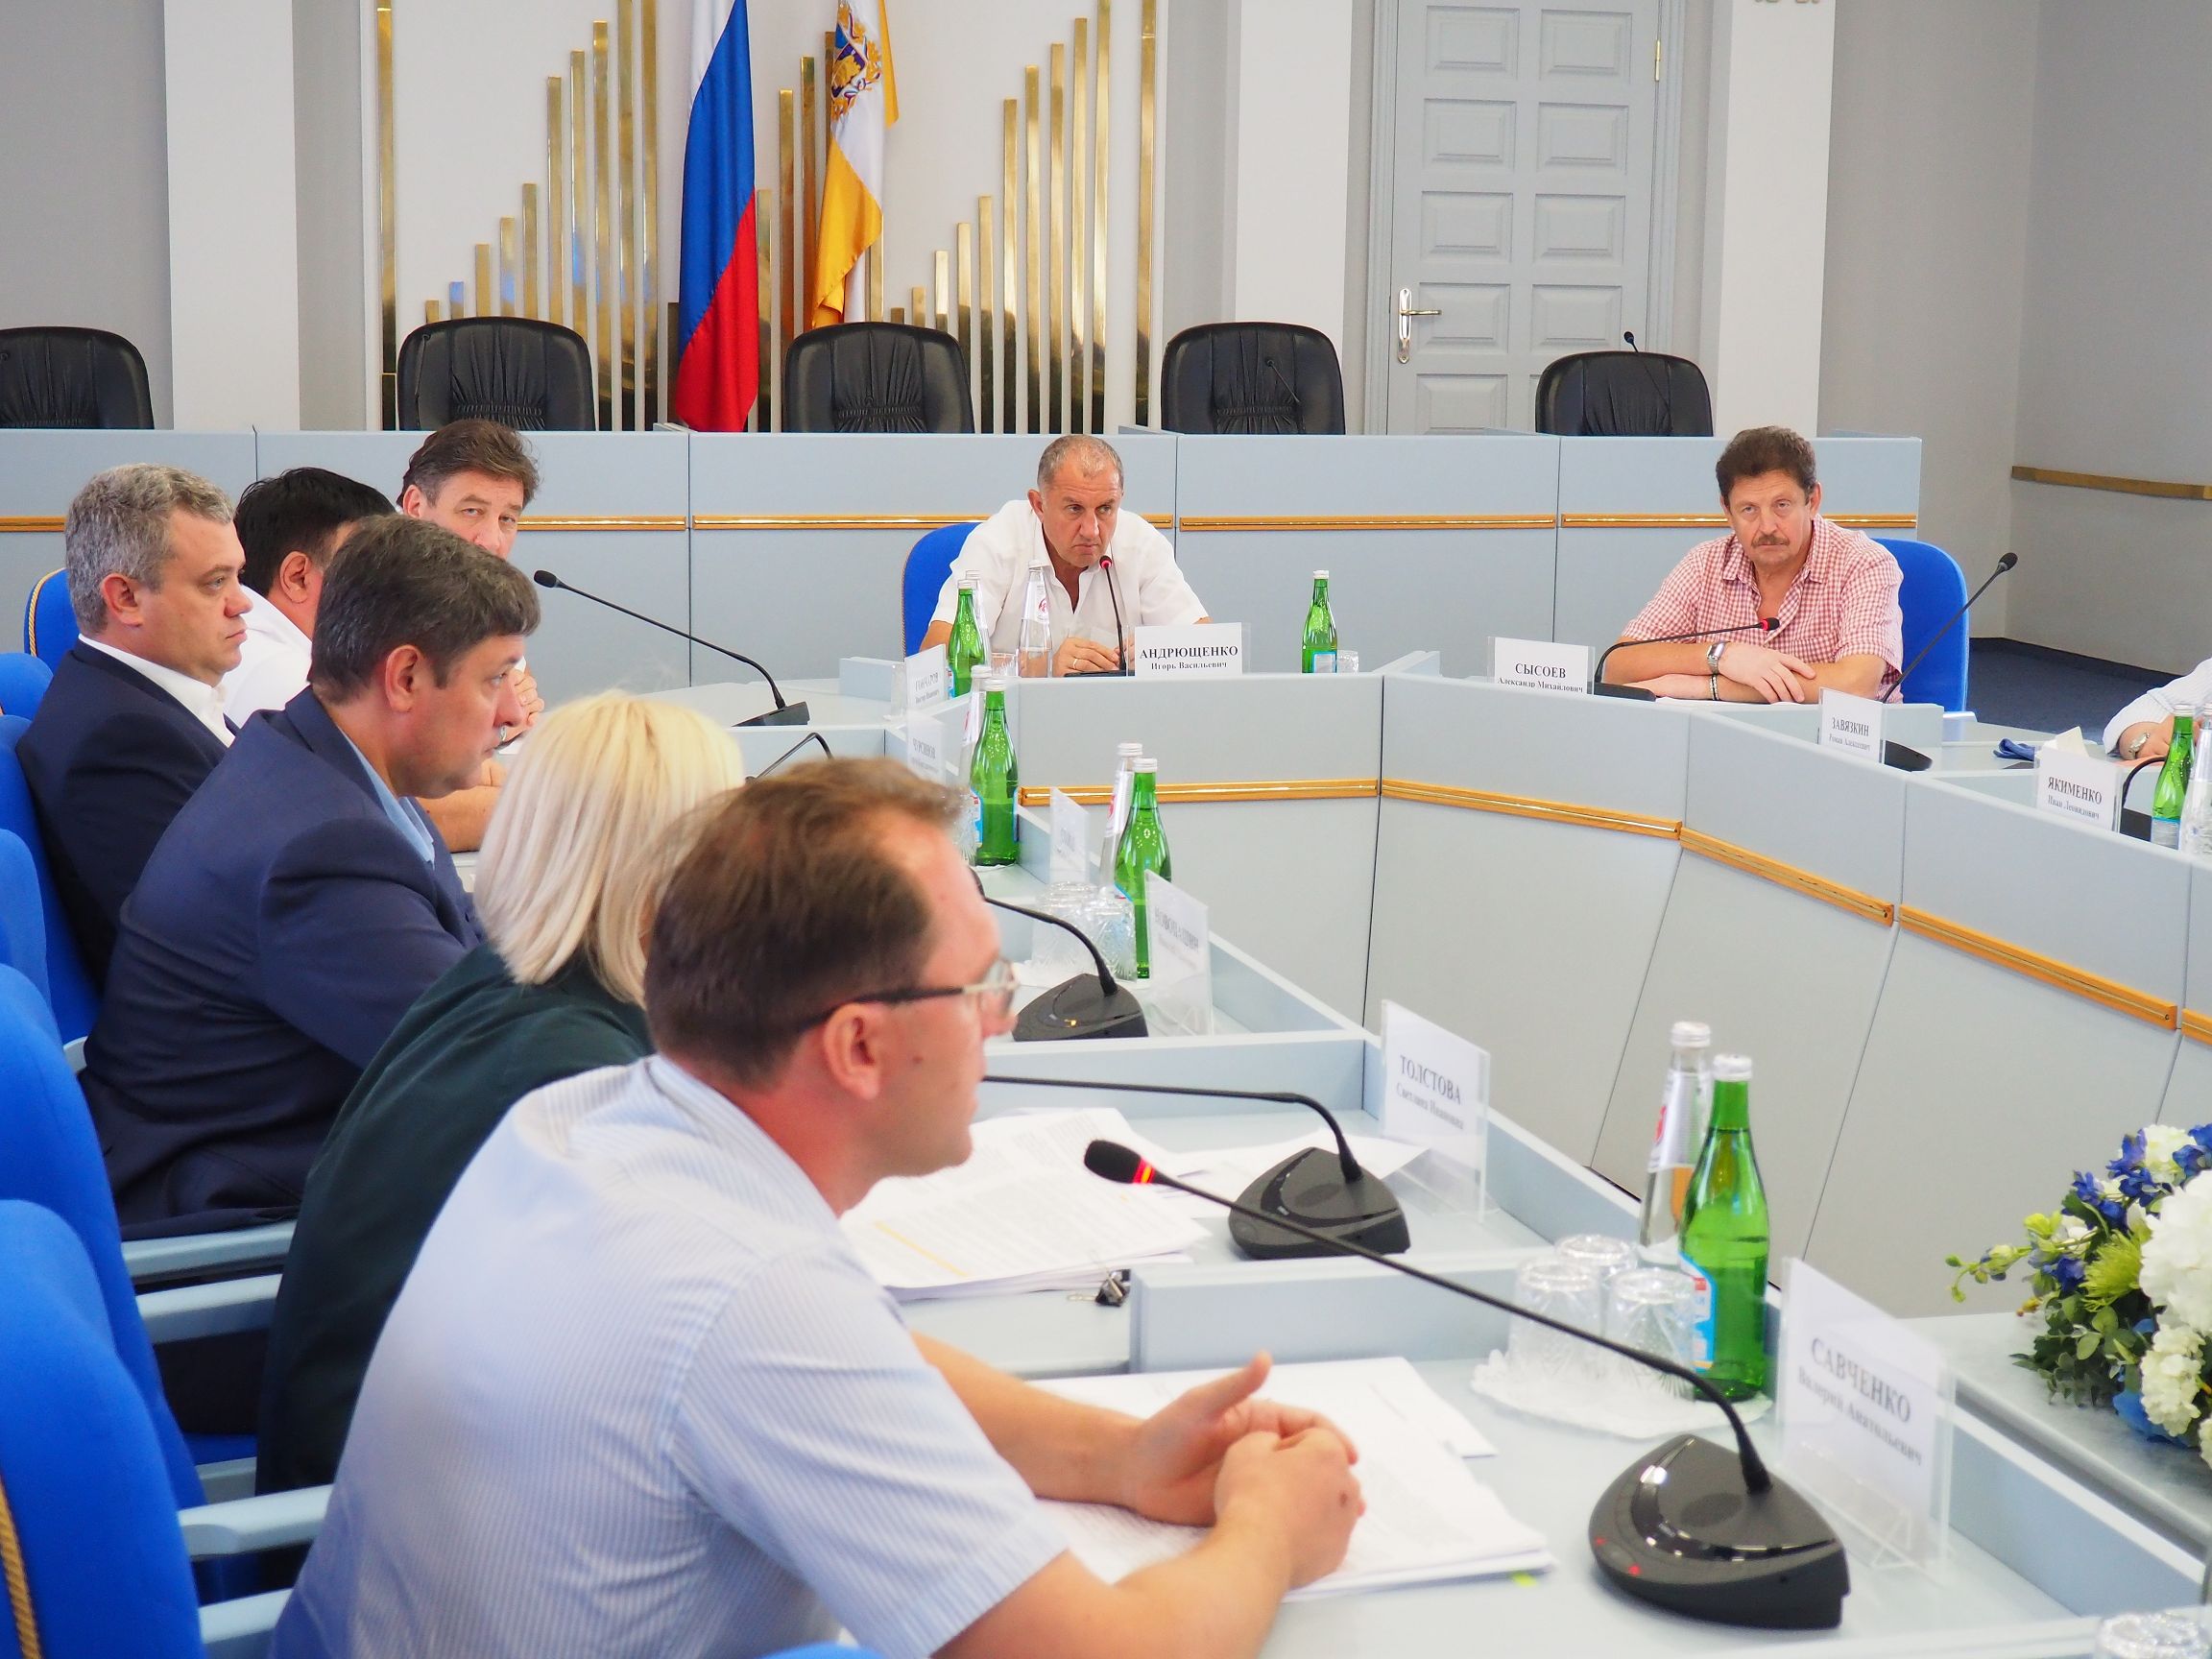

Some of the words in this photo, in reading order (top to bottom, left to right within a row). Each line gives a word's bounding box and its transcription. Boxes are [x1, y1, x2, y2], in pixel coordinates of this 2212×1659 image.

[1140, 645, 1238, 660] АНДРЮЩЕНКО
[1151, 662, 1176, 671] Игорь
[1179, 661, 1227, 670] Васильевич
[1515, 662, 1566, 679] СЫСОЕВ
[1498, 677, 1536, 688] Александр
[1537, 680, 1583, 693] Михайлович
[1832, 717, 1869, 736] ЗАВЯЗКИН
[2048, 777, 2103, 805] ЯКИМЕНКО
[2048, 794, 2063, 808] Иван
[1400, 1054, 1461, 1105] ТОЛСТОВА
[1811, 1337, 1911, 1423] САВЧЕНКО
